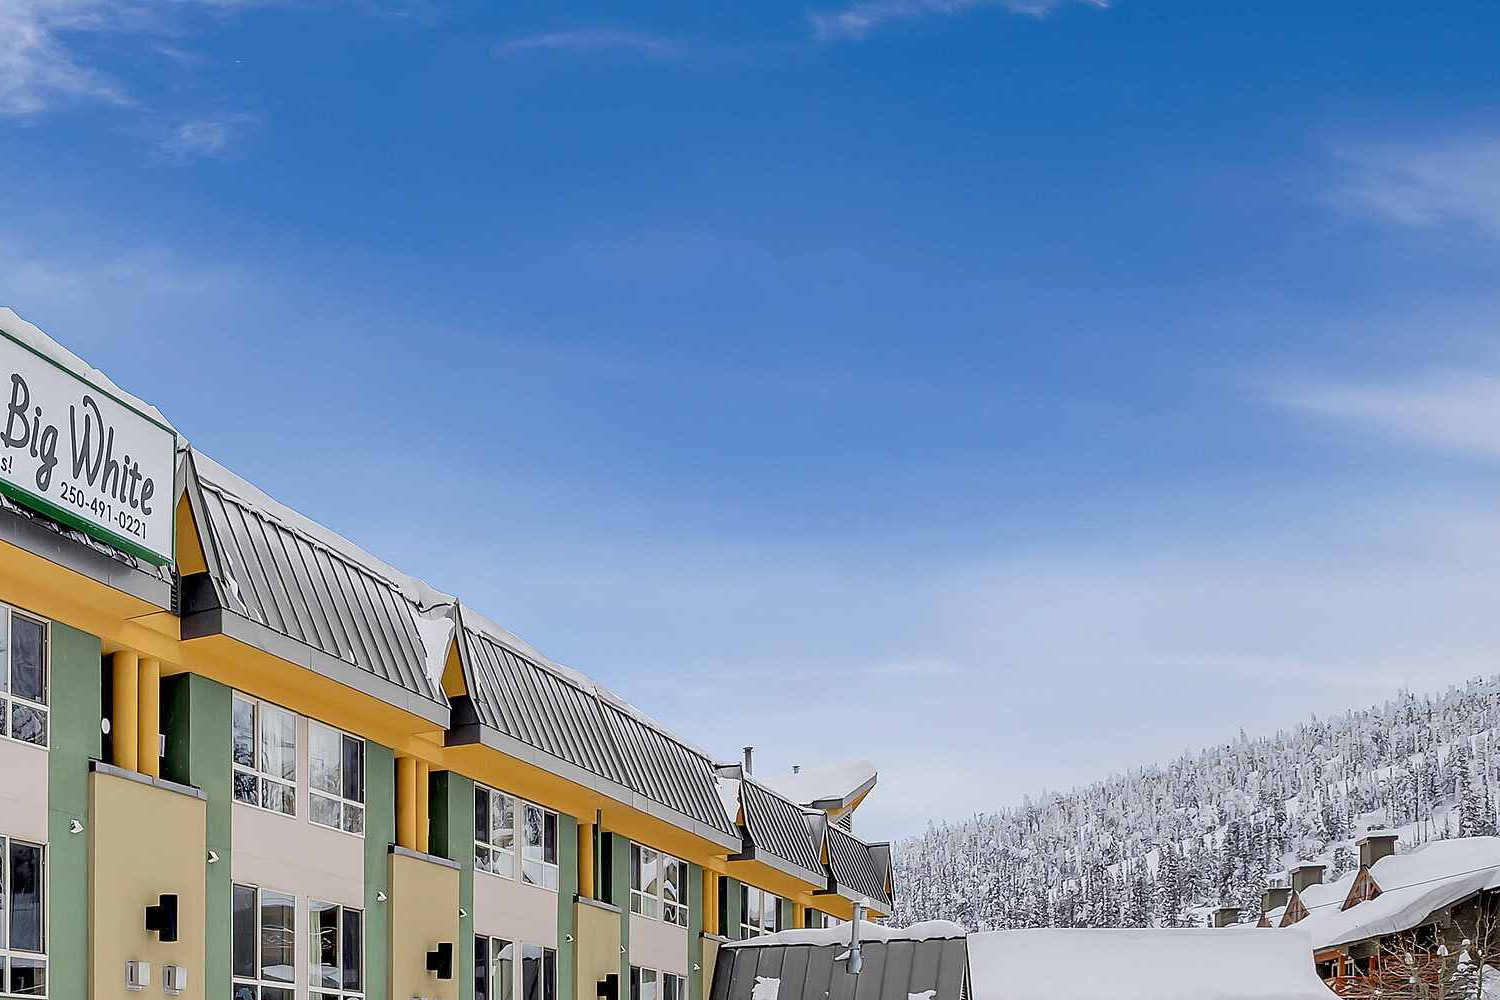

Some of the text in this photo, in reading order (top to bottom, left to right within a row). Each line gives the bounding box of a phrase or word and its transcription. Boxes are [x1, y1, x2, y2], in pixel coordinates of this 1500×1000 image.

[0, 373, 59, 492] Big
[69, 395, 156, 516] White
[60, 482, 147, 540] 250-491-0221
